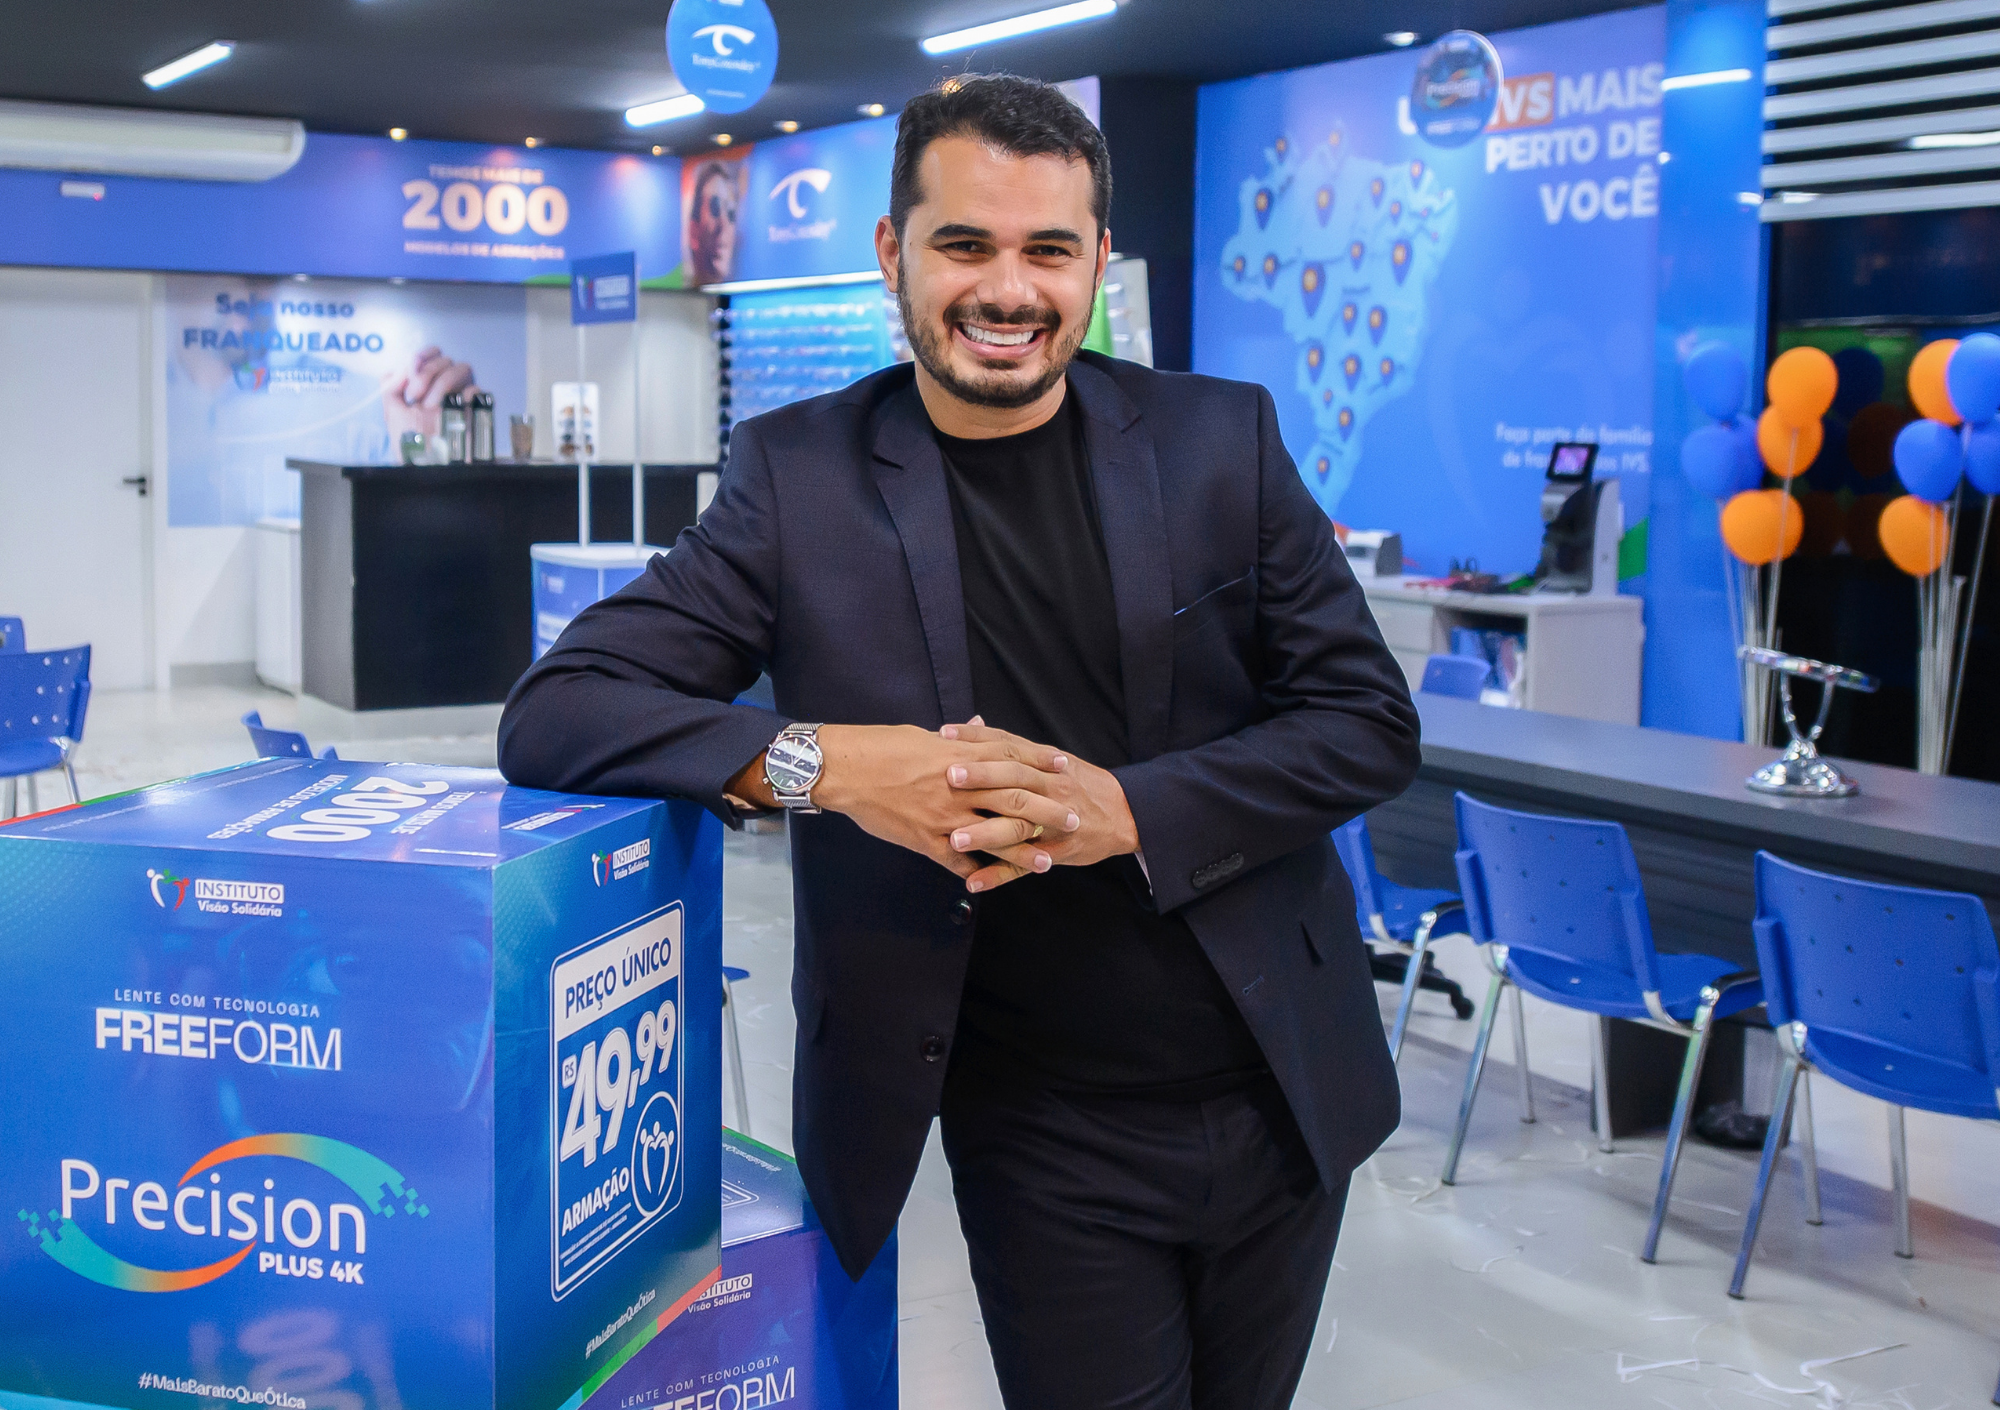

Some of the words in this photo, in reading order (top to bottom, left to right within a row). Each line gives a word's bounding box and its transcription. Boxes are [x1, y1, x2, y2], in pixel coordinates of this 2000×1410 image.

[1488, 80, 1551, 125] VS
[1559, 64, 1664, 117] MAIS
[1486, 126, 1598, 173] PERTO
[1608, 119, 1661, 159] DE
[403, 180, 569, 236] 2000
[1540, 163, 1659, 224] VOCÊ
[280, 301, 355, 318] nosso
[183, 327, 385, 353] FRANQUEADO
[266, 776, 450, 842] 2000
[613, 841, 649, 867] INSTITUTO
[197, 882, 281, 901] INSTITUTO
[198, 900, 229, 913] Visão
[232, 902, 283, 917] Solidária
[114, 988, 162, 1005] LENTE
[170, 993, 206, 1008] COM
[214, 996, 321, 1018] TECNOLOGIA
[565, 965, 617, 1019] PREÇO
[622, 937, 672, 988] ÚNICO
[96, 1007, 342, 1072] FREEFORM
[560, 999, 677, 1169] 49,99
[61, 1158, 367, 1254] Precision
[562, 1166, 631, 1237] ARMAÇÃO
[259, 1251, 324, 1280] PLUS
[330, 1260, 365, 1285] 4K
[701, 1276, 751, 1298] STITUTO
[585, 1288, 656, 1360] #MaisBaratoQueÓtica
[687, 1302, 712, 1314] Visão
[713, 1290, 752, 1308] Solidária
[138, 1372, 307, 1409] #MaisBaratoQueÓtica
[621, 1388, 660, 1408] LENTE
[665, 1379, 694, 1395] COM
[700, 1355, 781, 1385] TECNOLOGIA
